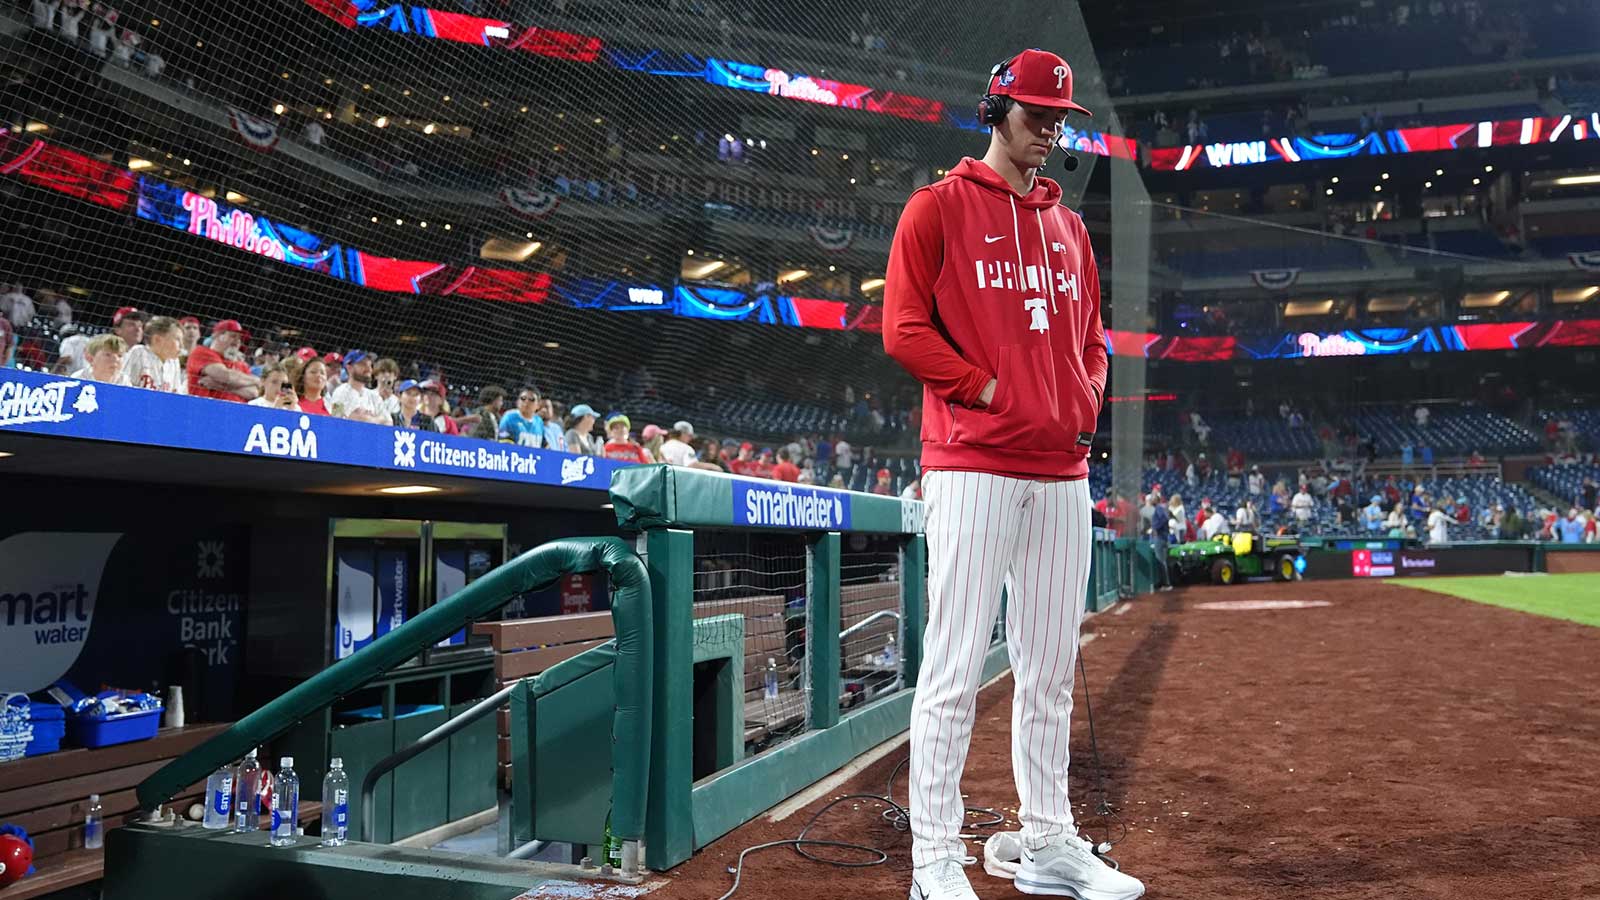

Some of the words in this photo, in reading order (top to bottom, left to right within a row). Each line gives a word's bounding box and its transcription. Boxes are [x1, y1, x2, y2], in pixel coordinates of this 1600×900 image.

[1053, 65, 1068, 89] P
[1205, 141, 1266, 167] WIN!
[182, 191, 285, 262] Phillies
[0, 381, 80, 423] GHOST
[244, 422, 318, 459] ABM
[420, 440, 476, 468] Citizens
[478, 448, 509, 472] Bank
[511, 452, 537, 475] Park
[746, 487, 832, 527] smartwater
[167, 589, 243, 615] Citizen
[393, 558, 404, 627] artwater
[35, 624, 87, 645] water
[181, 613, 232, 642] Bank
[185, 639, 228, 666] rk
[220, 777, 232, 811] smart
